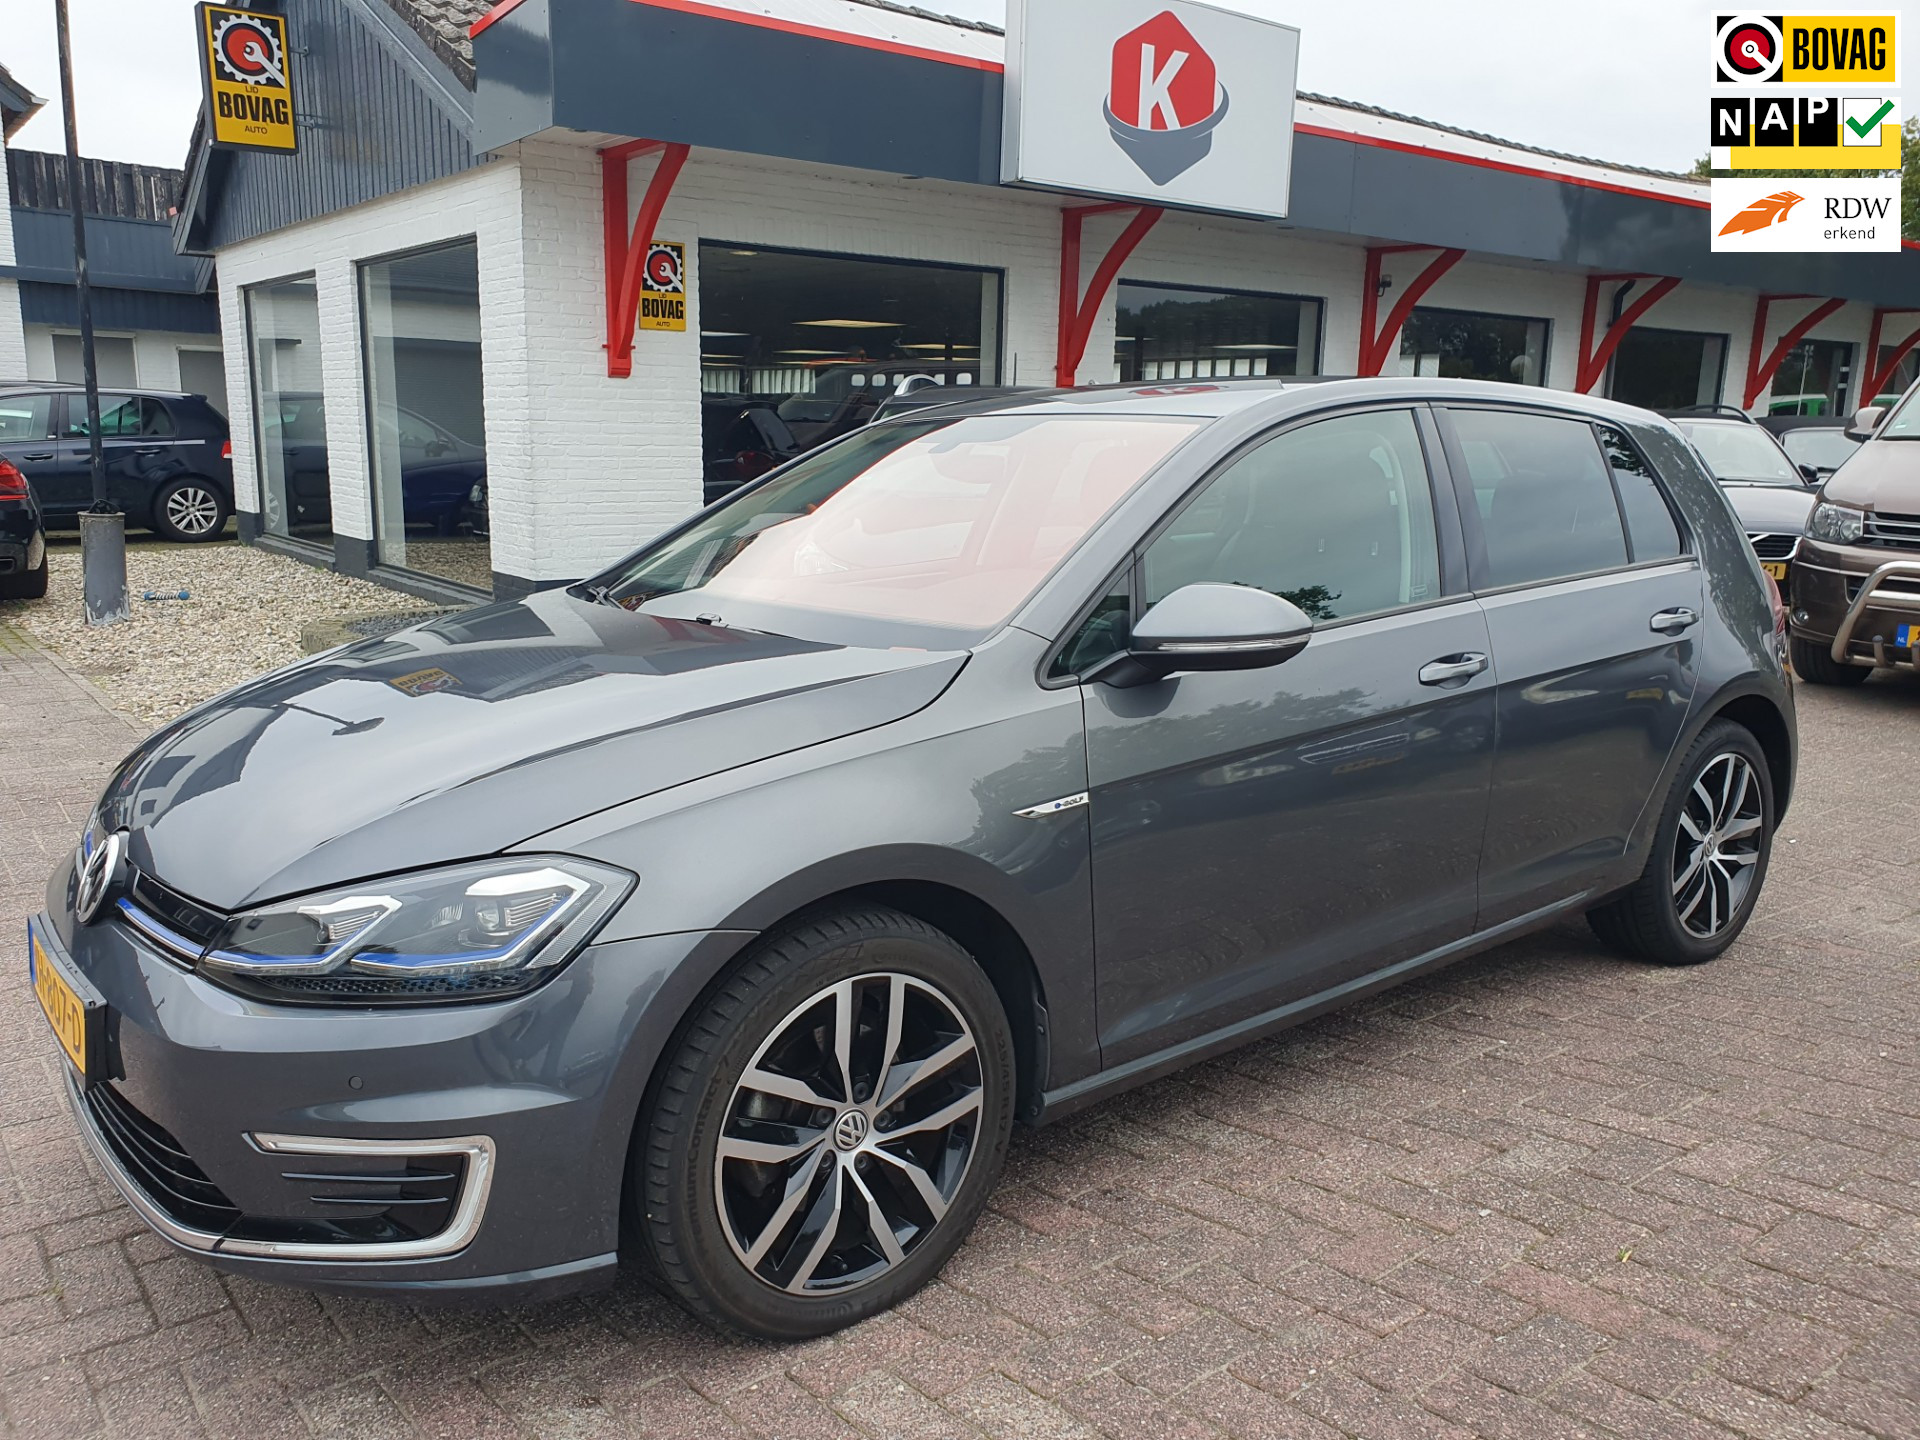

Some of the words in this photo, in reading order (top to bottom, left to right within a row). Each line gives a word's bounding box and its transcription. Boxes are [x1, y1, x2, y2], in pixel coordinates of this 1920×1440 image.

[245, 85, 259, 94] LID
[1138, 43, 1190, 130] K
[217, 91, 289, 126] BOVAG
[244, 125, 268, 135] AUTO
[641, 297, 684, 320] BOVAG
